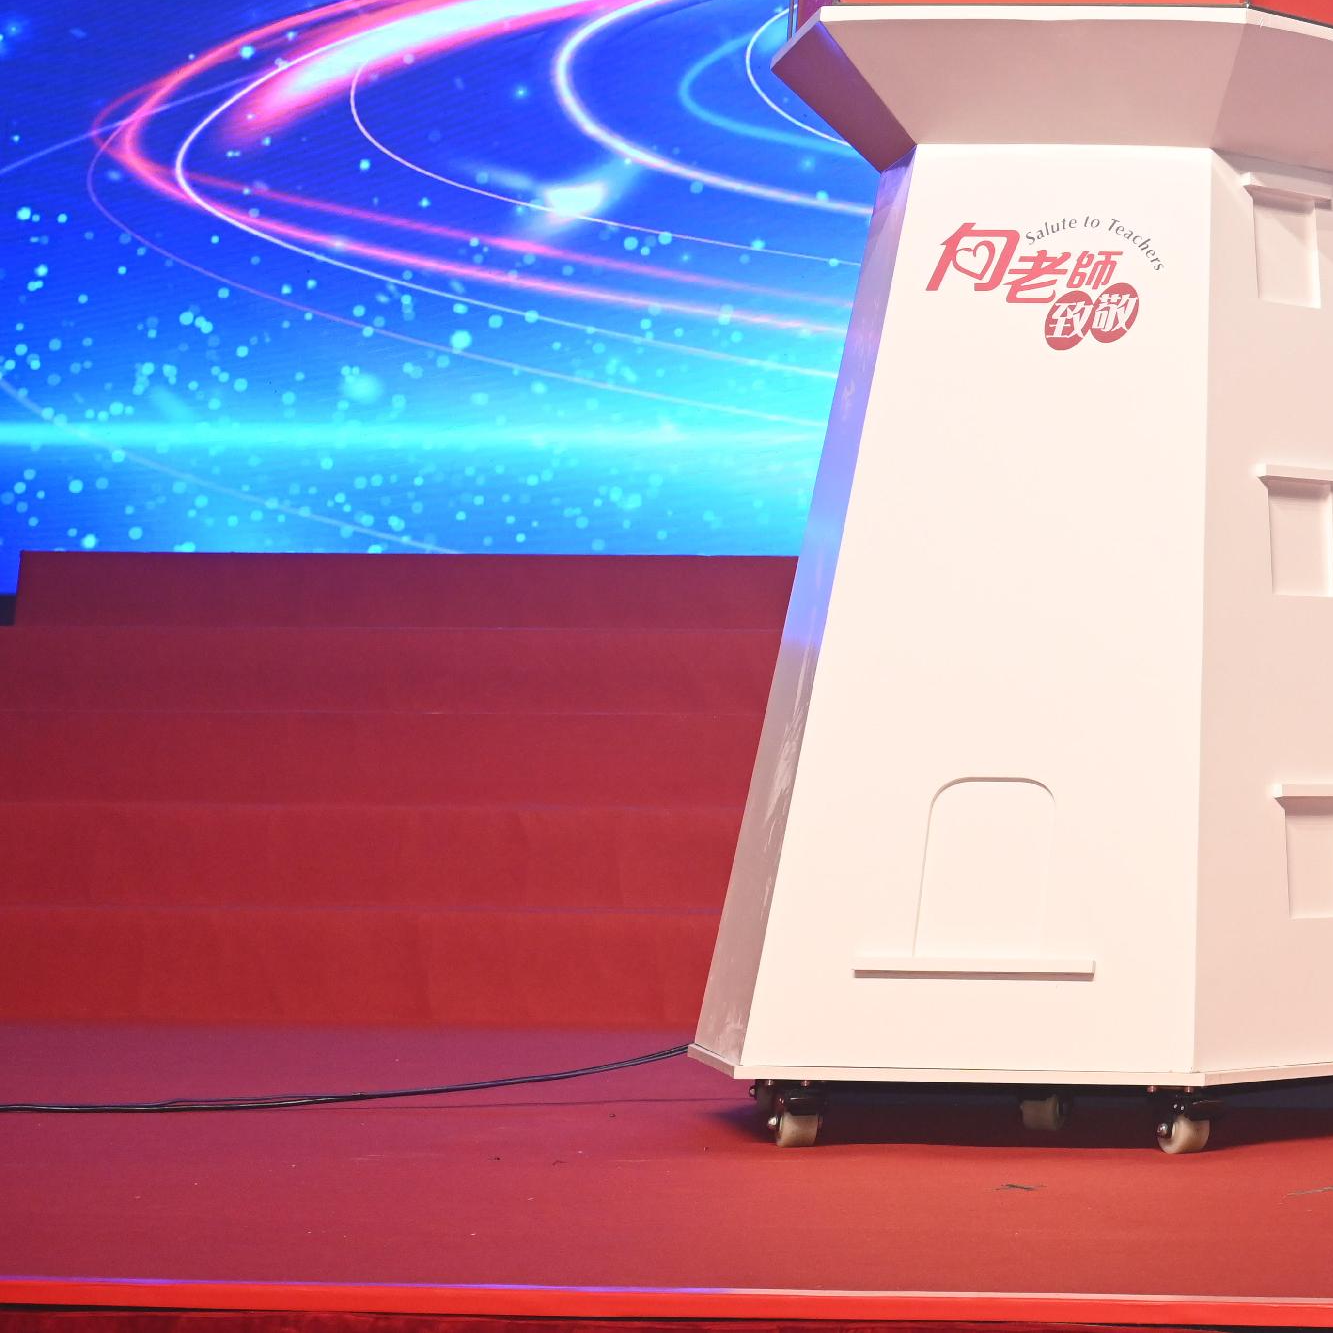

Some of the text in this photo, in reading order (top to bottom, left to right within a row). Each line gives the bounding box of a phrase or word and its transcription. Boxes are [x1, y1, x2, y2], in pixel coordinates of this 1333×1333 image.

[1025, 215, 1165, 272] Salute to Teachers
